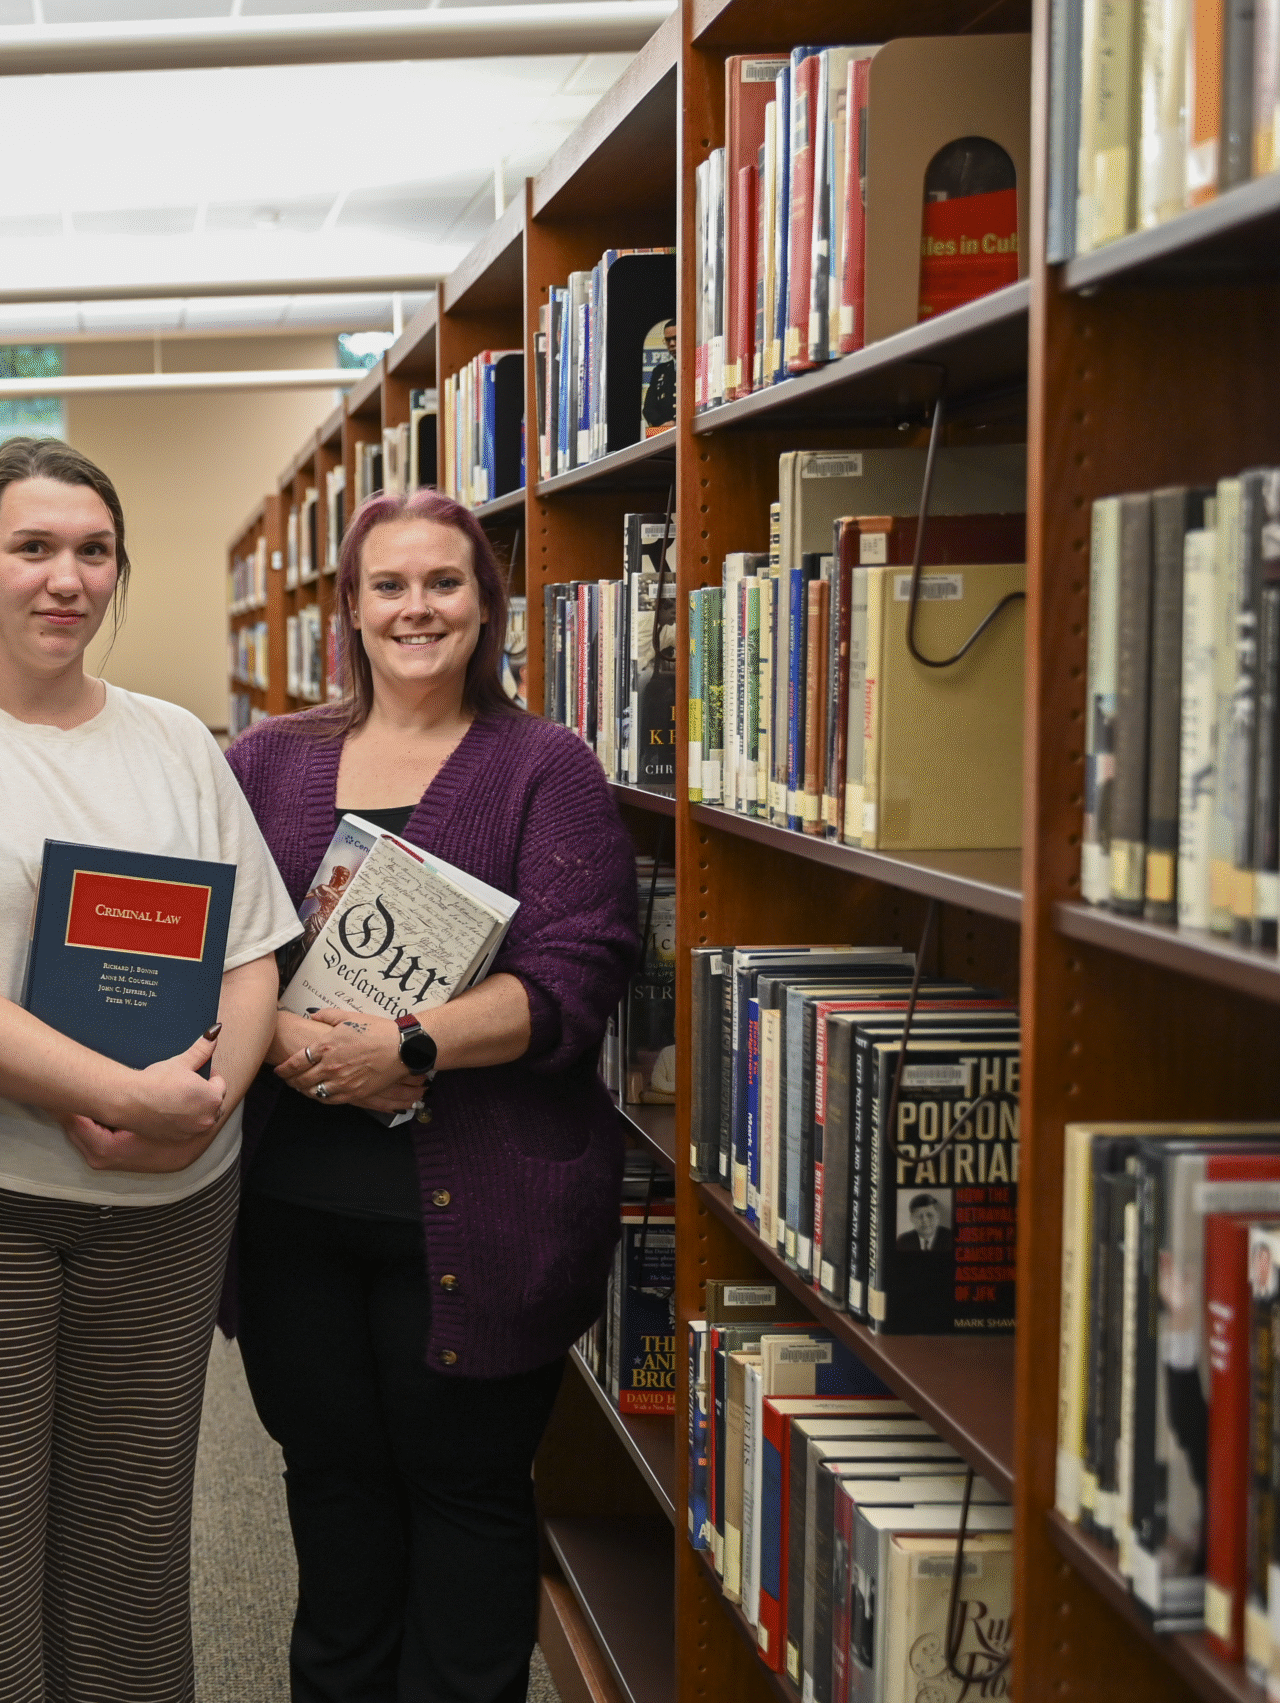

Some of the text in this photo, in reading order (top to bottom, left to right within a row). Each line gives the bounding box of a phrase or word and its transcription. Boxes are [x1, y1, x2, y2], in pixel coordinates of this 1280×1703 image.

[959, 234, 980, 255] in
[730, 617, 736, 634] AN
[832, 579, 841, 704] WARREN REPORT
[645, 764, 674, 776] CHR
[95, 904, 181, 925] CRIMINAL LAW
[338, 893, 451, 1006] Our
[100, 974, 159, 986] ANNE M. COUGHLIN
[103, 962, 159, 975] RICHARD J. BONNIE
[323, 937, 412, 1020] Declaratio
[98, 984, 114, 992] JOHN
[302, 979, 340, 1010] DECLARATI
[106, 996, 148, 1007] PETER W. LOW
[815, 1016, 825, 1118] KILLING KENNEDY
[959, 1057, 1020, 1099] THE
[764, 1057, 773, 1160] BEST EVIDENCE
[897, 1101, 1020, 1142] POISON
[851, 1053, 863, 1259] DEEP POLITICS AND THE DEATH OF
[867, 1097, 880, 1270] THE POISON PATRIARCH
[814, 1169, 822, 1235] BILL O'REILLY
[954, 1317, 1018, 1329] MARK SHAW
[642, 1353, 675, 1370] AN
[627, 1393, 663, 1404] DAVID
